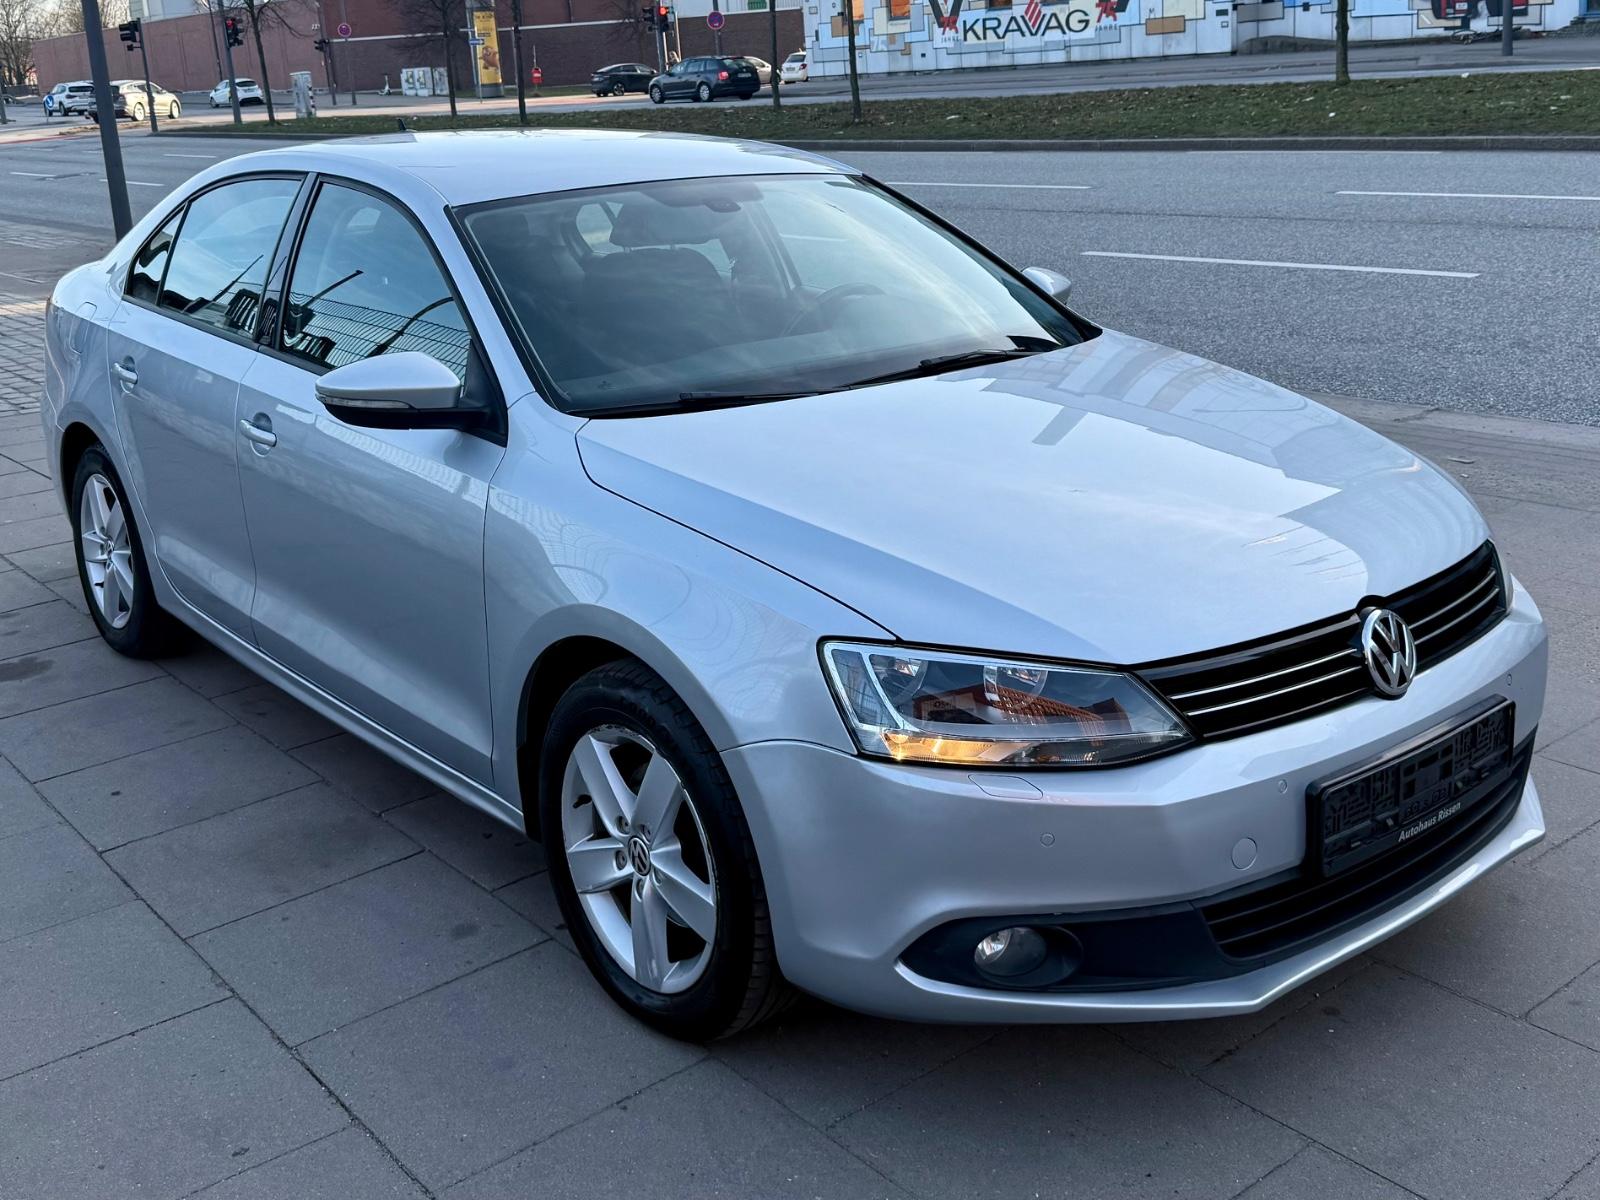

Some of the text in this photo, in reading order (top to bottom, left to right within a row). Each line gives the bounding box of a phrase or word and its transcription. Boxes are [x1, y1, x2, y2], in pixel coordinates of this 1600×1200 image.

[962, 9, 1091, 42] KRAVAG
[1398, 802, 1461, 842] Autohaus Rissen
